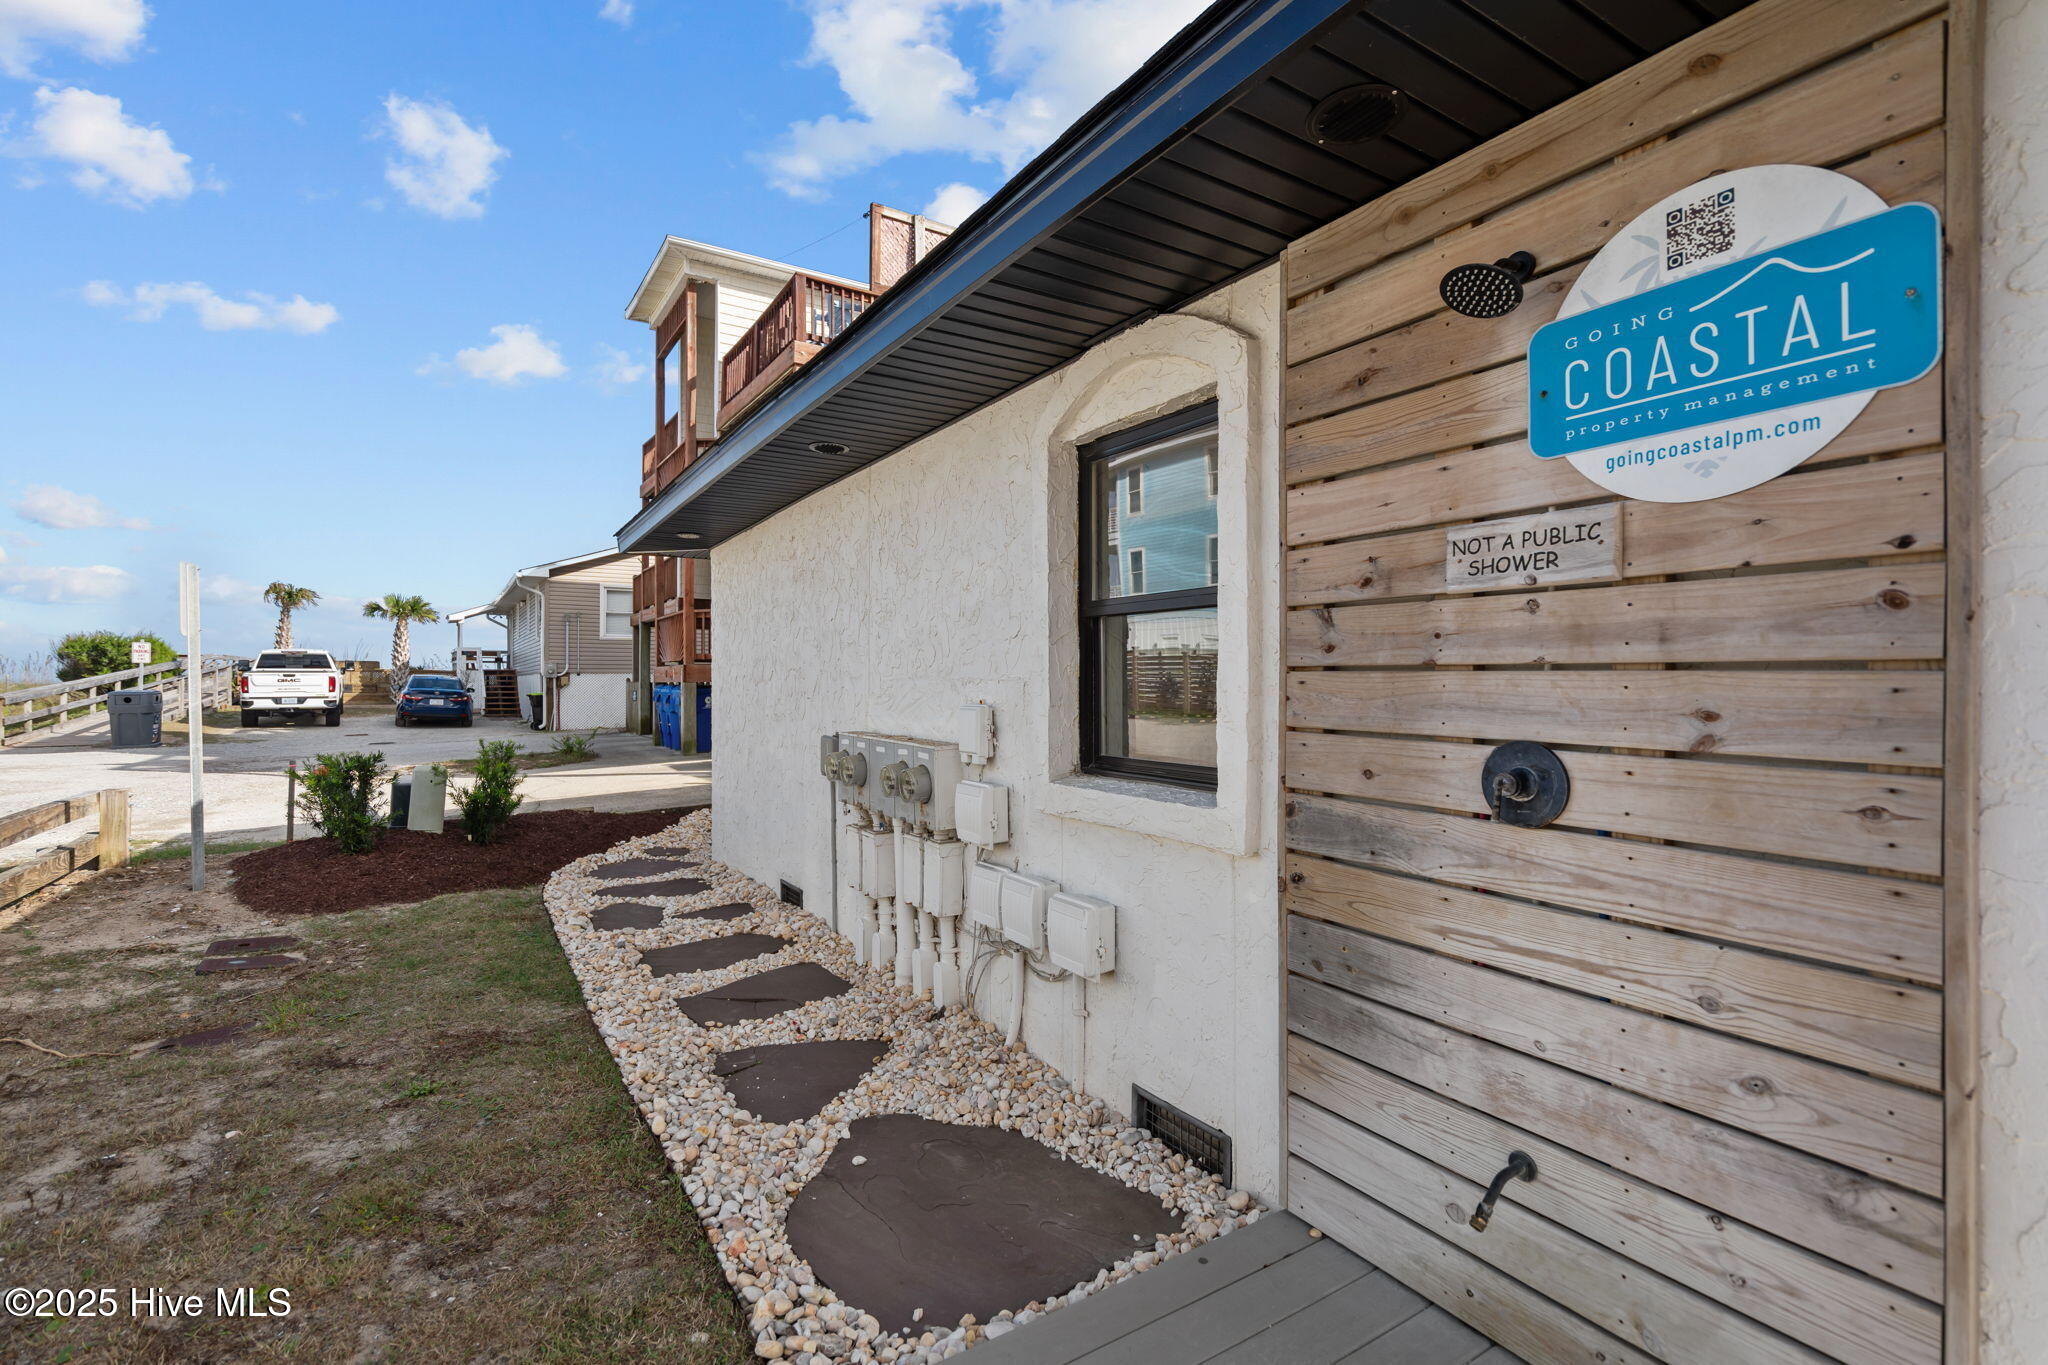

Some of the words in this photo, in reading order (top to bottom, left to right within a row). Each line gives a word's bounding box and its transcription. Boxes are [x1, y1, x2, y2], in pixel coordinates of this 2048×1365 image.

[1564, 306, 1673, 350] GOING
[1565, 281, 1877, 410] COASTAL
[1565, 407, 1669, 441] property
[1684, 358, 1876, 411] management
[1606, 415, 1821, 474] goingcoastalpm.com
[1452, 536, 1496, 557] NOT
[1501, 534, 1515, 551] A
[1522, 521, 1602, 549] PUBLIC
[1467, 550, 1560, 577] SHOWER
